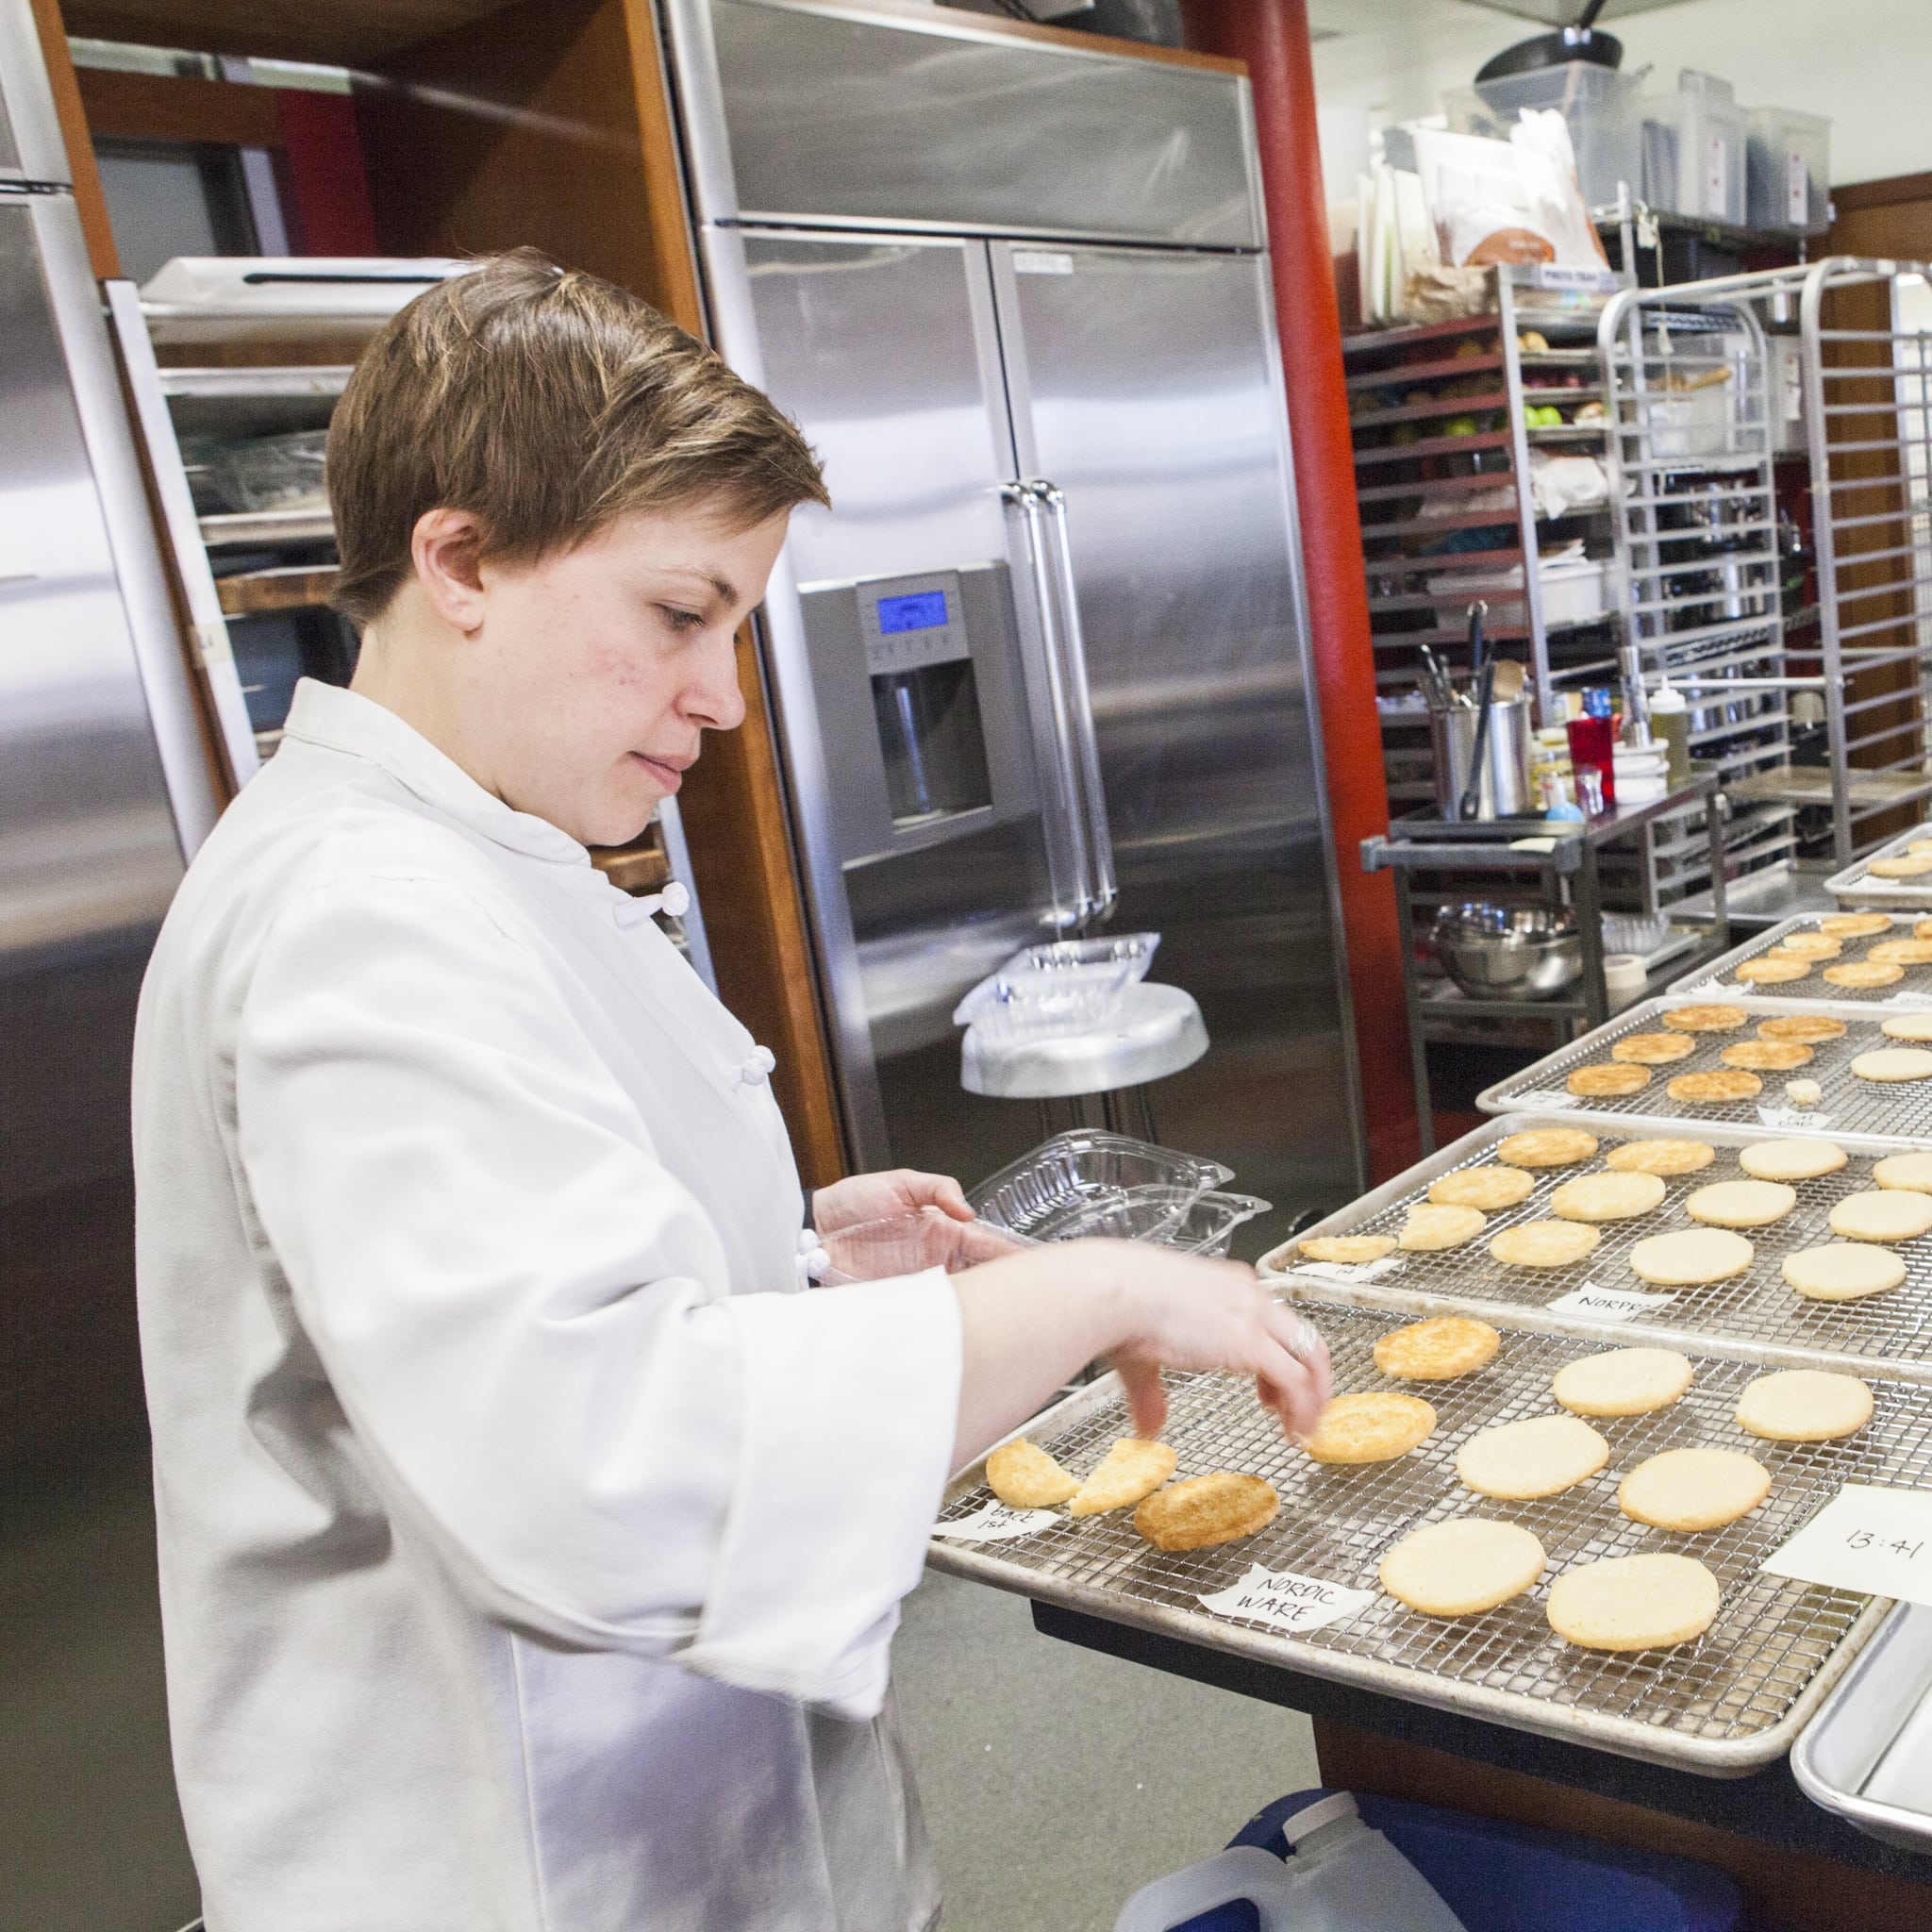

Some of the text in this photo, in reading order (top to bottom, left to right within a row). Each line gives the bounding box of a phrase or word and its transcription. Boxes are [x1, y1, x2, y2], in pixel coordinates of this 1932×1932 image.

[1846, 1529, 1924, 1558] 13:41
[1257, 1576, 1336, 1605] NORDIC
[1237, 1595, 1316, 1622] WARE
